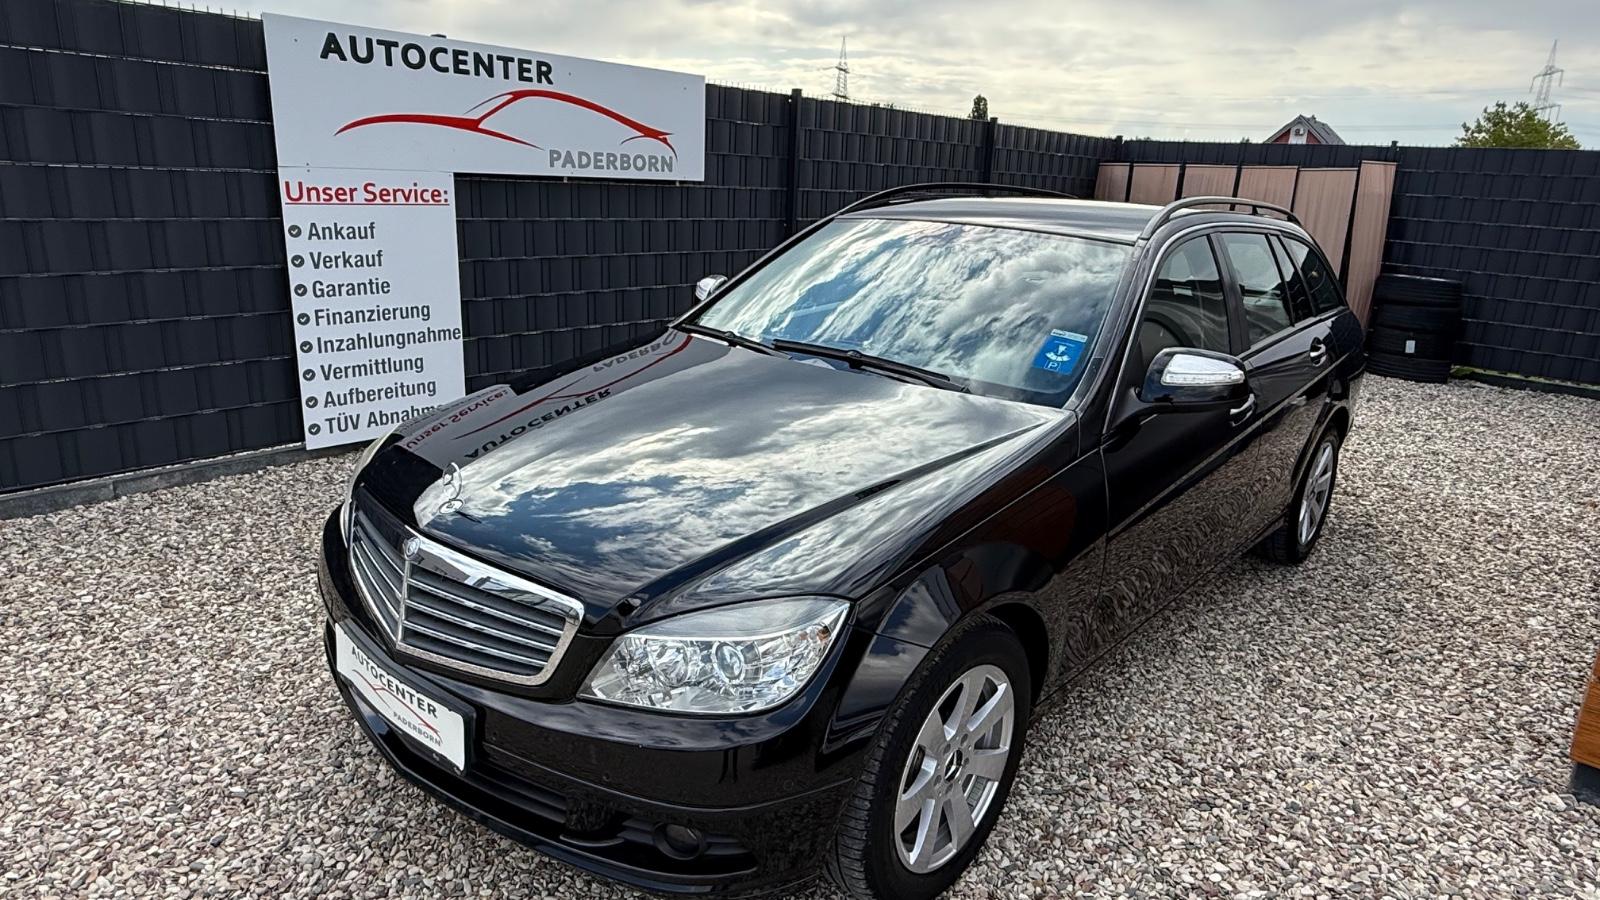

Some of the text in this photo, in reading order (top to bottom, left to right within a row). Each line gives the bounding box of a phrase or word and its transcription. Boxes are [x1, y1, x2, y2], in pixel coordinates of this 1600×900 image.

[320, 32, 554, 85] AUTOCENTER
[549, 149, 674, 172] PADERBORN
[285, 181, 449, 203] Unser Service:
[308, 222, 375, 241] Ankauf
[310, 250, 383, 269] Verkauf
[312, 278, 391, 298] Garantie
[314, 304, 431, 326] Finanzierung
[317, 327, 461, 354] Inzahlungnahme
[320, 356, 424, 381] Vermittlung
[323, 381, 436, 408] Aufbereitung
[325, 413, 360, 434] TÜV
[351, 646, 438, 719] AUTOCENTER
[393, 711, 442, 747] PADERBORN
